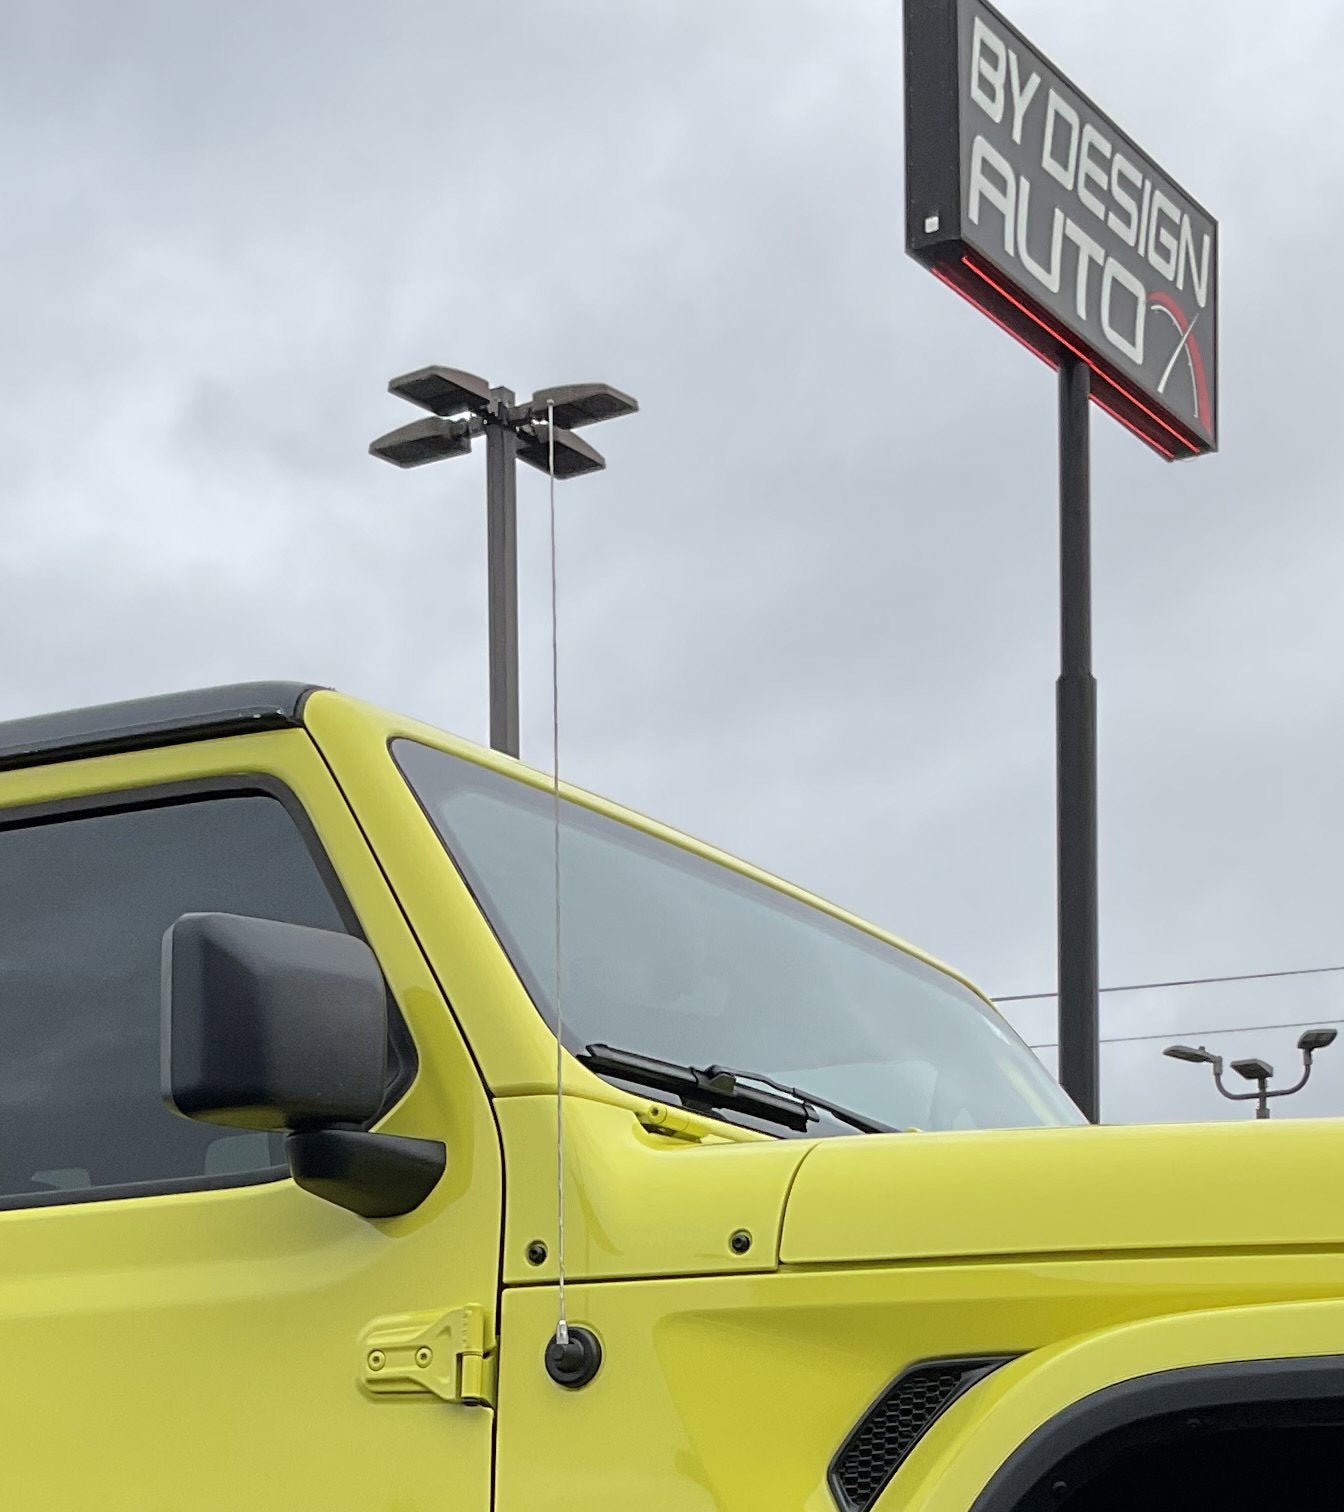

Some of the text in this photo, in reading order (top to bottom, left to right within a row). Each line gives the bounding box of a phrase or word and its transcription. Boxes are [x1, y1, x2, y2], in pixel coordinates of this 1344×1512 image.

[968, 135, 1146, 365] AUTO
[970, 15, 1210, 308] BY DESIGN
